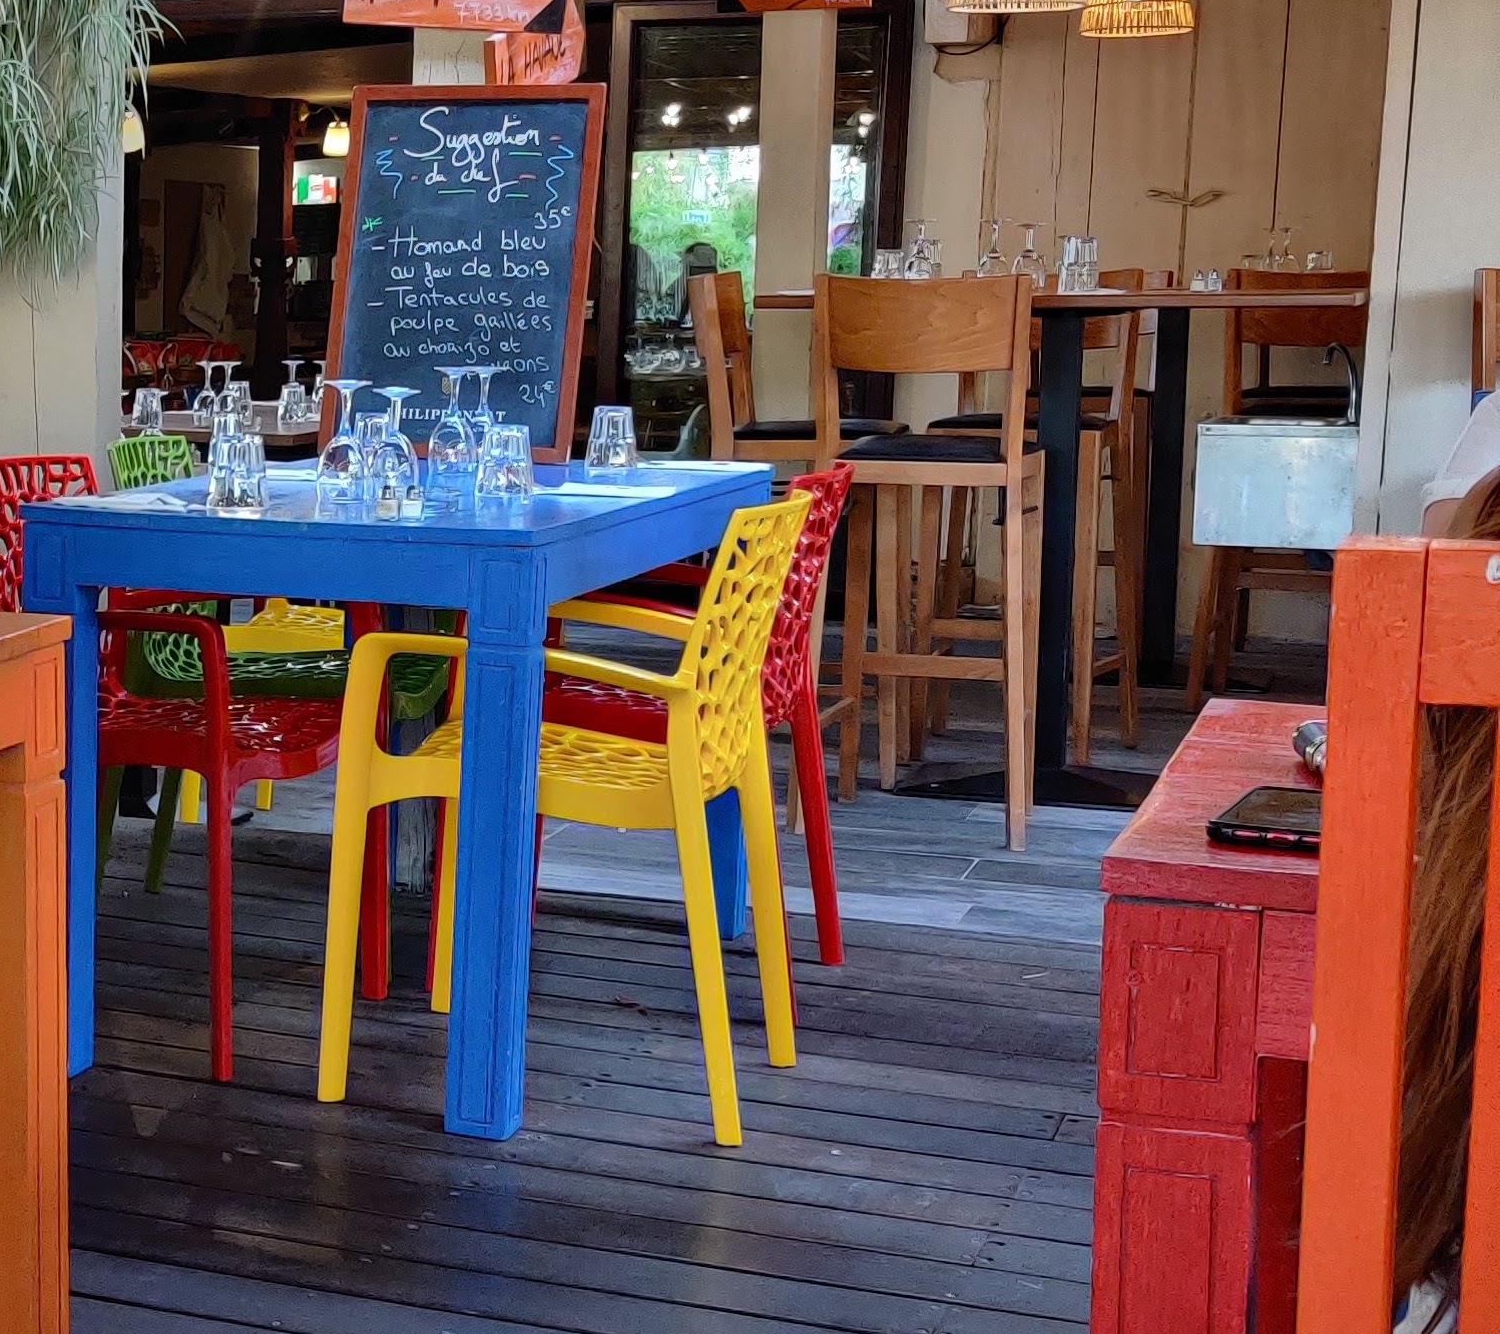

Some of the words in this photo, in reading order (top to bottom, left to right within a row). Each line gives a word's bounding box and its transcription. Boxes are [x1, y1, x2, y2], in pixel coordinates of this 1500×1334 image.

[403, 106, 540, 166] Suggestion
[460, 148, 519, 203] chef
[501, 228, 547, 251] bleu
[391, 266, 415, 280] au
[424, 261, 451, 289] feu
[461, 256, 493, 278] de
[502, 254, 550, 278] bois
[385, 286, 513, 310] Tentacules
[523, 291, 551, 309] de
[390, 310, 460, 336] poulpe
[383, 341, 411, 358] au
[499, 336, 521, 353] et
